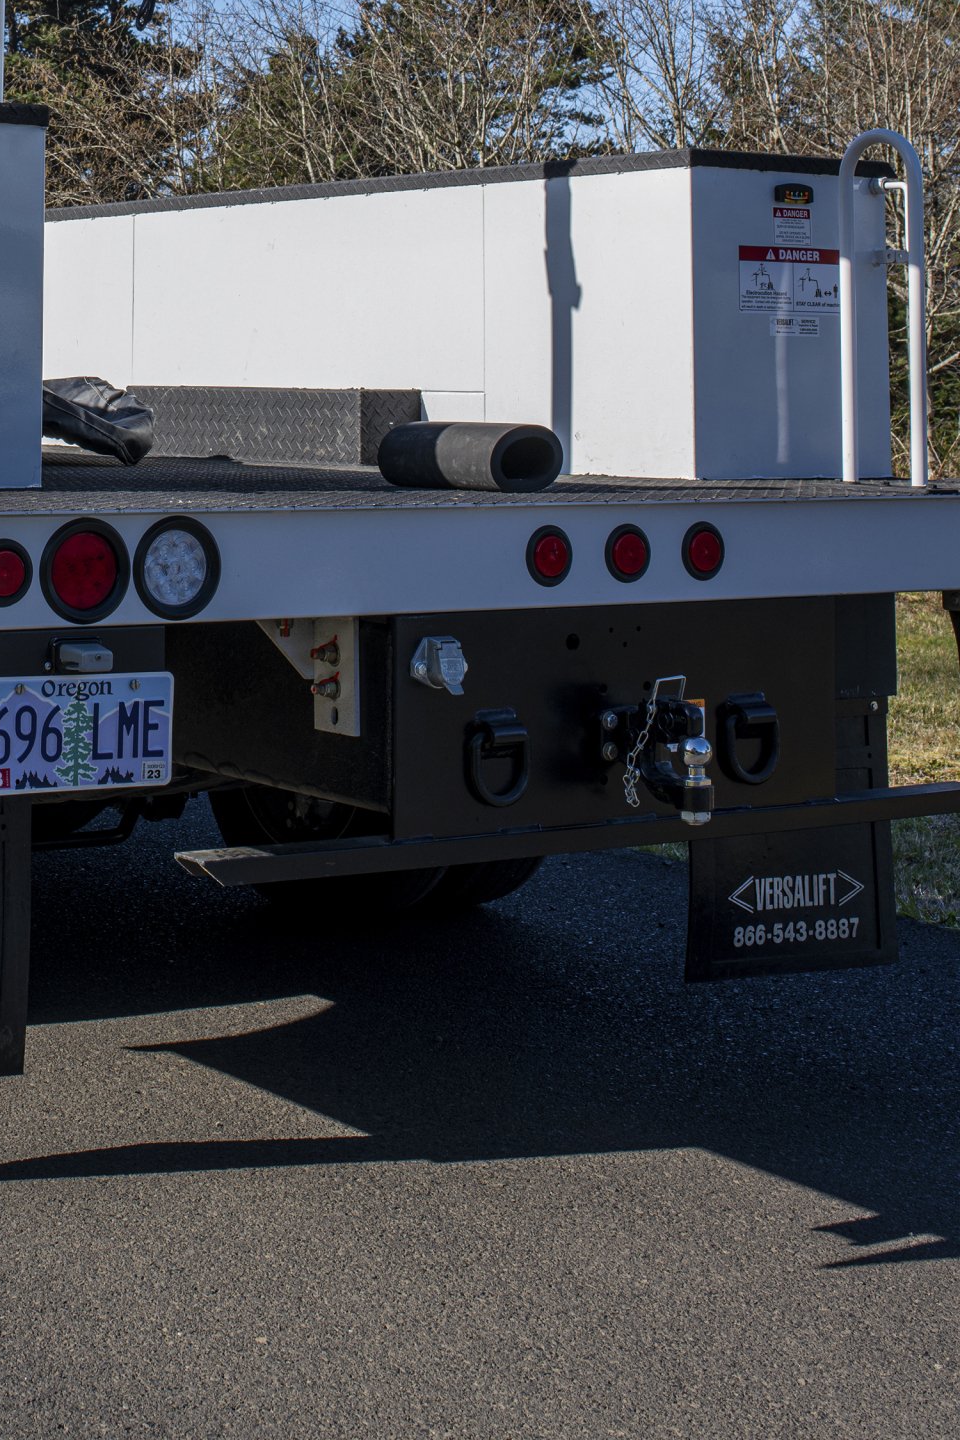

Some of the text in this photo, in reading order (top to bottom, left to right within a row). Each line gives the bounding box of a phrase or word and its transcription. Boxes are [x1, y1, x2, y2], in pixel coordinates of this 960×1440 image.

[782, 209, 809, 218] DANGER
[778, 249, 820, 262] DANGER
[41, 680, 114, 701] Oregon
[92, 699, 166, 760] LME
[147, 769, 161, 779] 23
[754, 872, 837, 911] VERSALIFT
[733, 917, 859, 948] 866-543-8887
